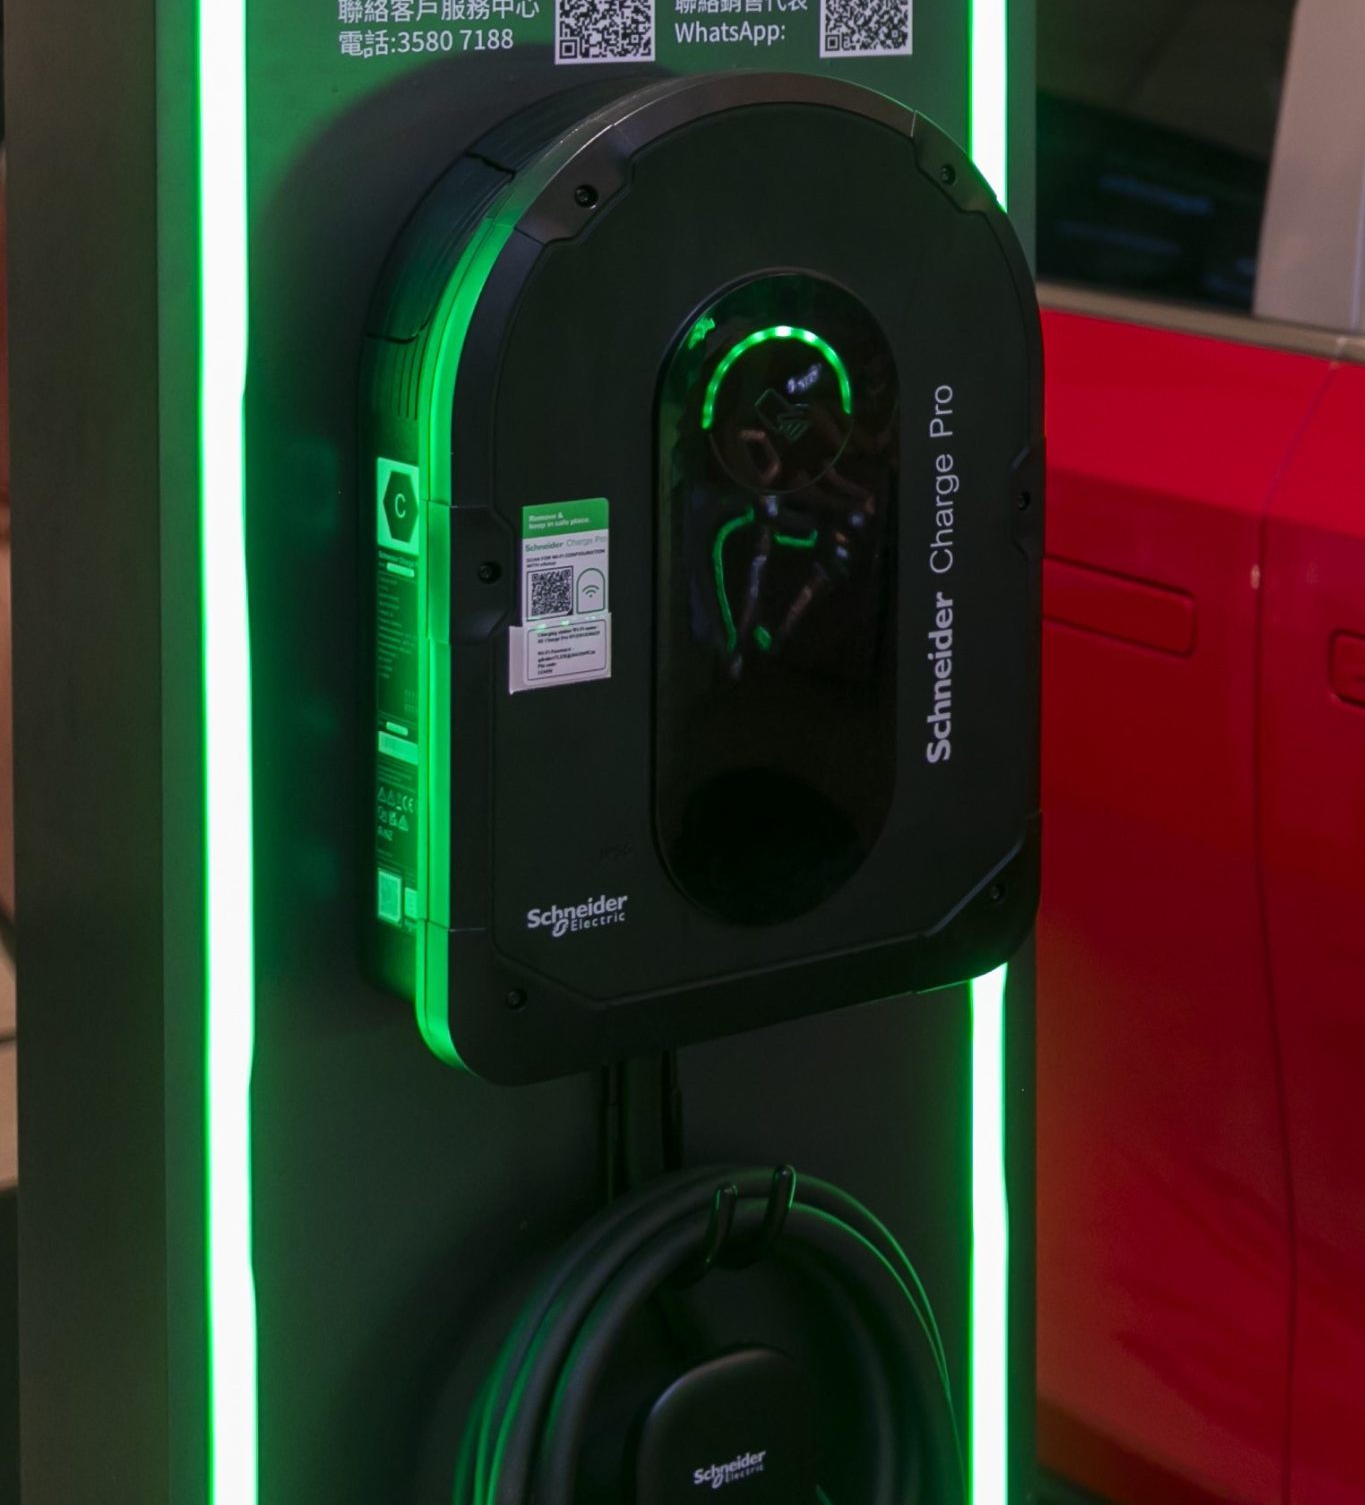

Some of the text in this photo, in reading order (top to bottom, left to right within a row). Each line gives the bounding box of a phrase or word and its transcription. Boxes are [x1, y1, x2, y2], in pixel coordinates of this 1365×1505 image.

[459, 28, 514, 50] 7188
[675, 20, 786, 46] WhatsApp:
[525, 541, 564, 552] Schneider
[566, 537, 593, 548] Charge
[926, 384, 960, 764] Schneider Charge Pro
[527, 895, 628, 929] Schneider
[570, 912, 626, 932] Electric
[694, 1450, 766, 1485] Schneider
